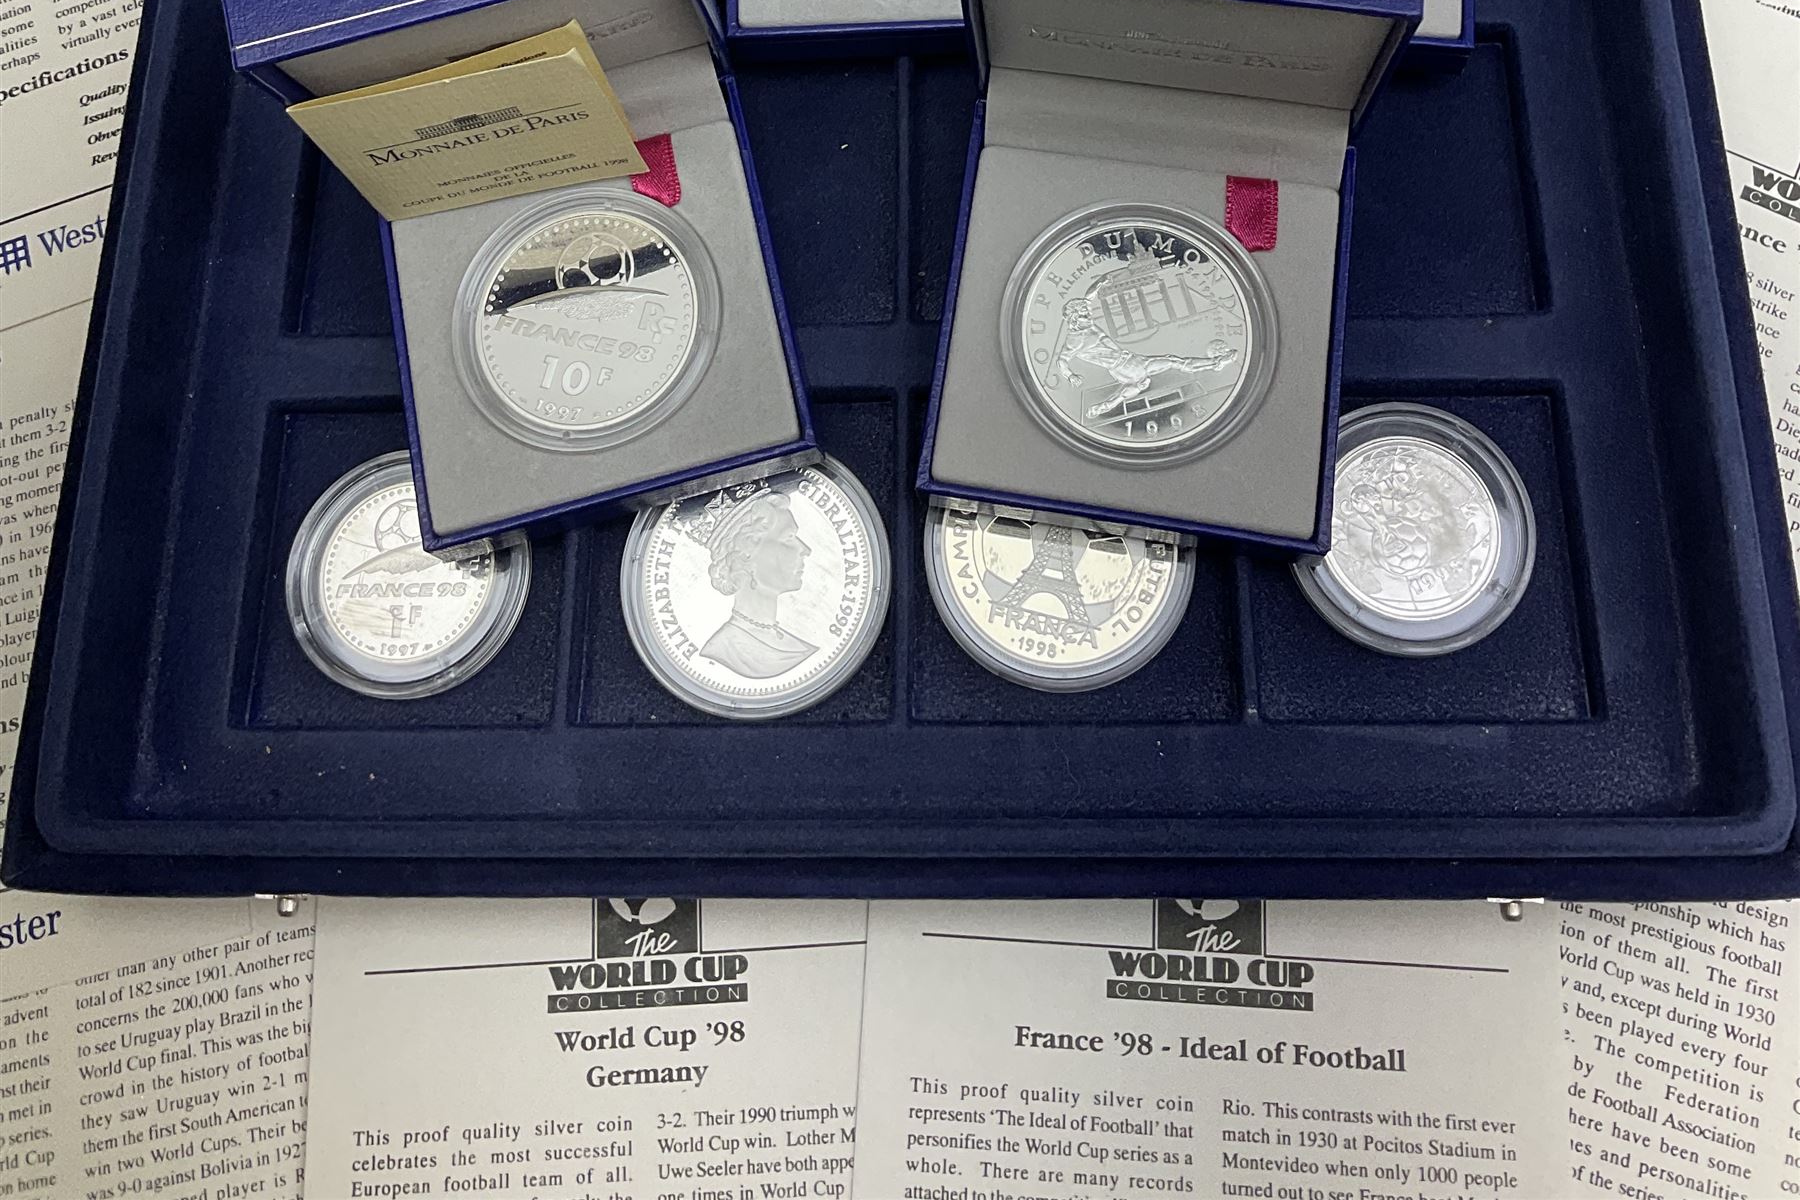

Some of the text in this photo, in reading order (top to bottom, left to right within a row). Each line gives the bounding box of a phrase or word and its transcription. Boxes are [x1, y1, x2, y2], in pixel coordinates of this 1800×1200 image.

[368, 109, 589, 167] MONNAIE DE PARIS
[494, 316, 656, 362] FRANCE 98
[540, 356, 614, 396] 10 F
[536, 399, 584, 421] 1997
[336, 582, 467, 598] FRANCE 98
[655, 539, 698, 661] ELIZABETH
[988, 605, 1098, 650] FRANÇA
[380, 642, 420, 656] 1997
[625, 927, 677, 957] The
[1186, 924, 1241, 952] The
[548, 953, 748, 991] WORLD CUP
[1108, 951, 1314, 988] WORLD CUP
[556, 986, 741, 1011] COLLECTION
[1116, 982, 1305, 1008] COLLECTION
[121, 1002, 261, 1049] Uruguay play Brazil
[555, 1024, 635, 1052] World
[644, 1026, 697, 1051] Cup
[1015, 1024, 1104, 1055] France
[1179, 1037, 1247, 1063] Ideal
[1255, 1041, 1287, 1065] of
[1292, 1043, 1407, 1073] Football
[586, 1062, 709, 1089] Germany
[1573, 1055, 1760, 1128] by the Federation
[910, 1077, 1194, 1112] This proof quality silver coin
[353, 1116, 633, 1147] This proof quality silver coin
[1222, 1152, 1518, 1191] Montevideo when only 1000 people
